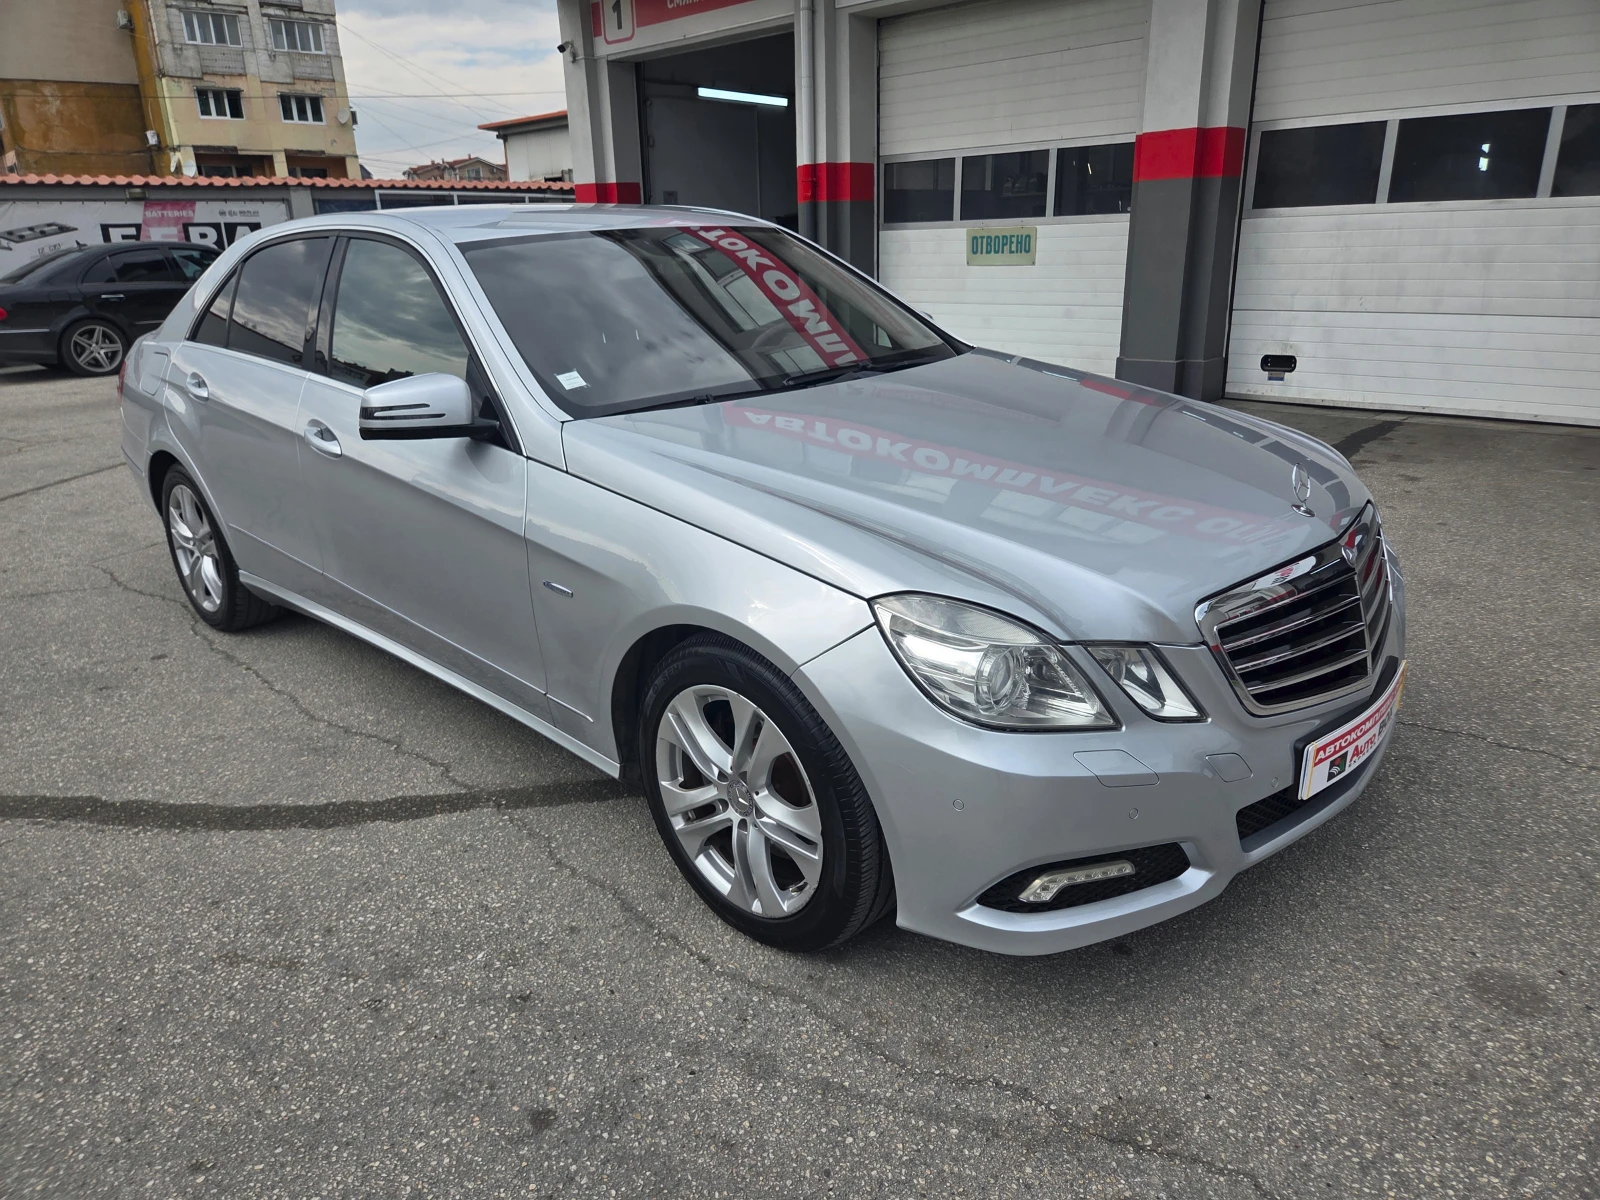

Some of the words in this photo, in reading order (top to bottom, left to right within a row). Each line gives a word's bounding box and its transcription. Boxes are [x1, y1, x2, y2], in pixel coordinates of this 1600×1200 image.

[611, 0, 622, 30] 1
[145, 210, 194, 218] BATTERIES
[971, 233, 1032, 255] ОТВОРЕНО
